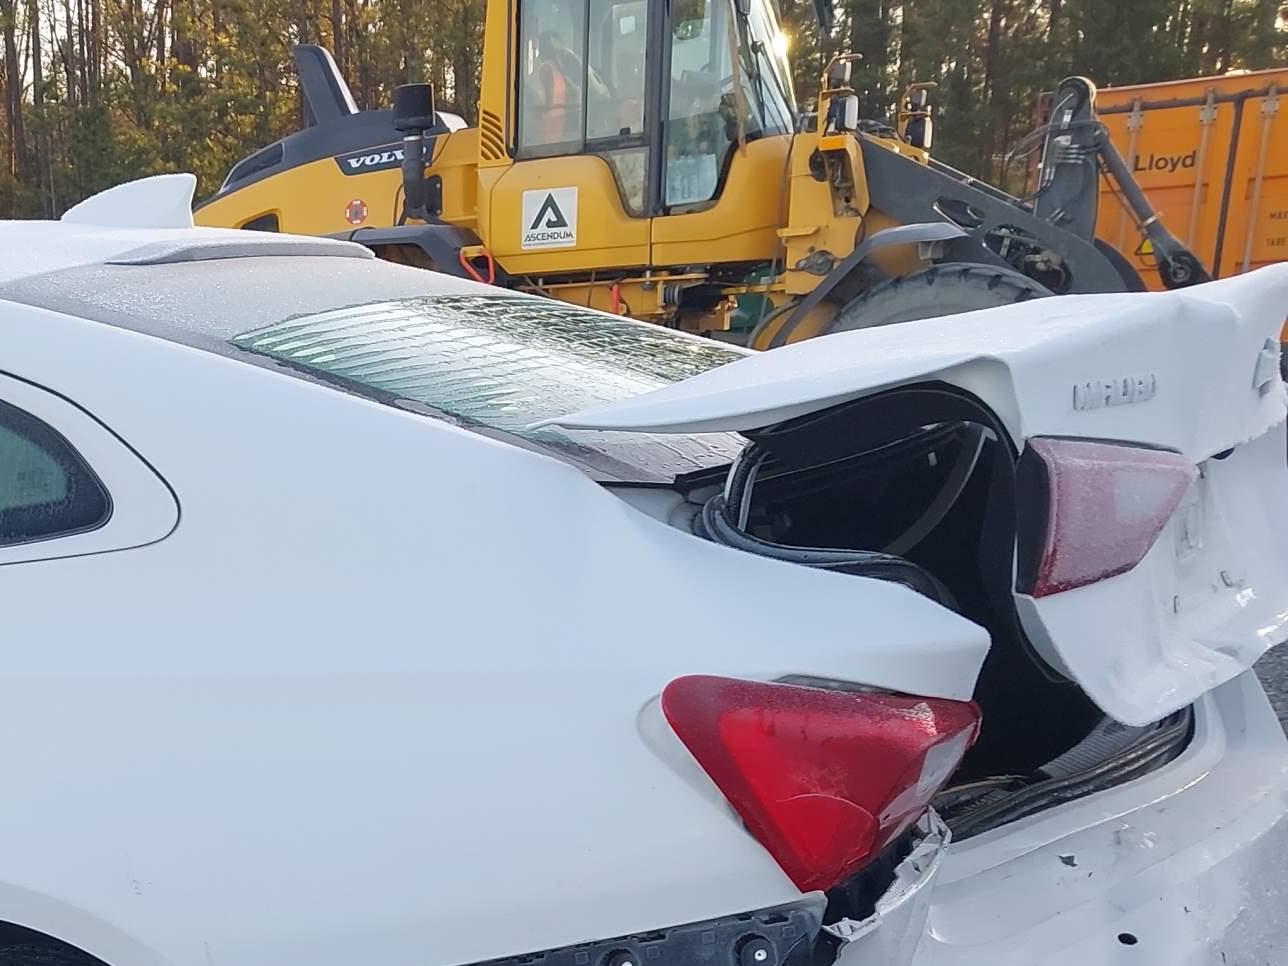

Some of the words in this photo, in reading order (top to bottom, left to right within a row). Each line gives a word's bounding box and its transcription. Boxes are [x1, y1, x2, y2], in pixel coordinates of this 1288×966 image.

[346, 146, 426, 168] VOLV
[1134, 150, 1197, 173] Lloyd
[523, 231, 574, 242] ASCENDUM
